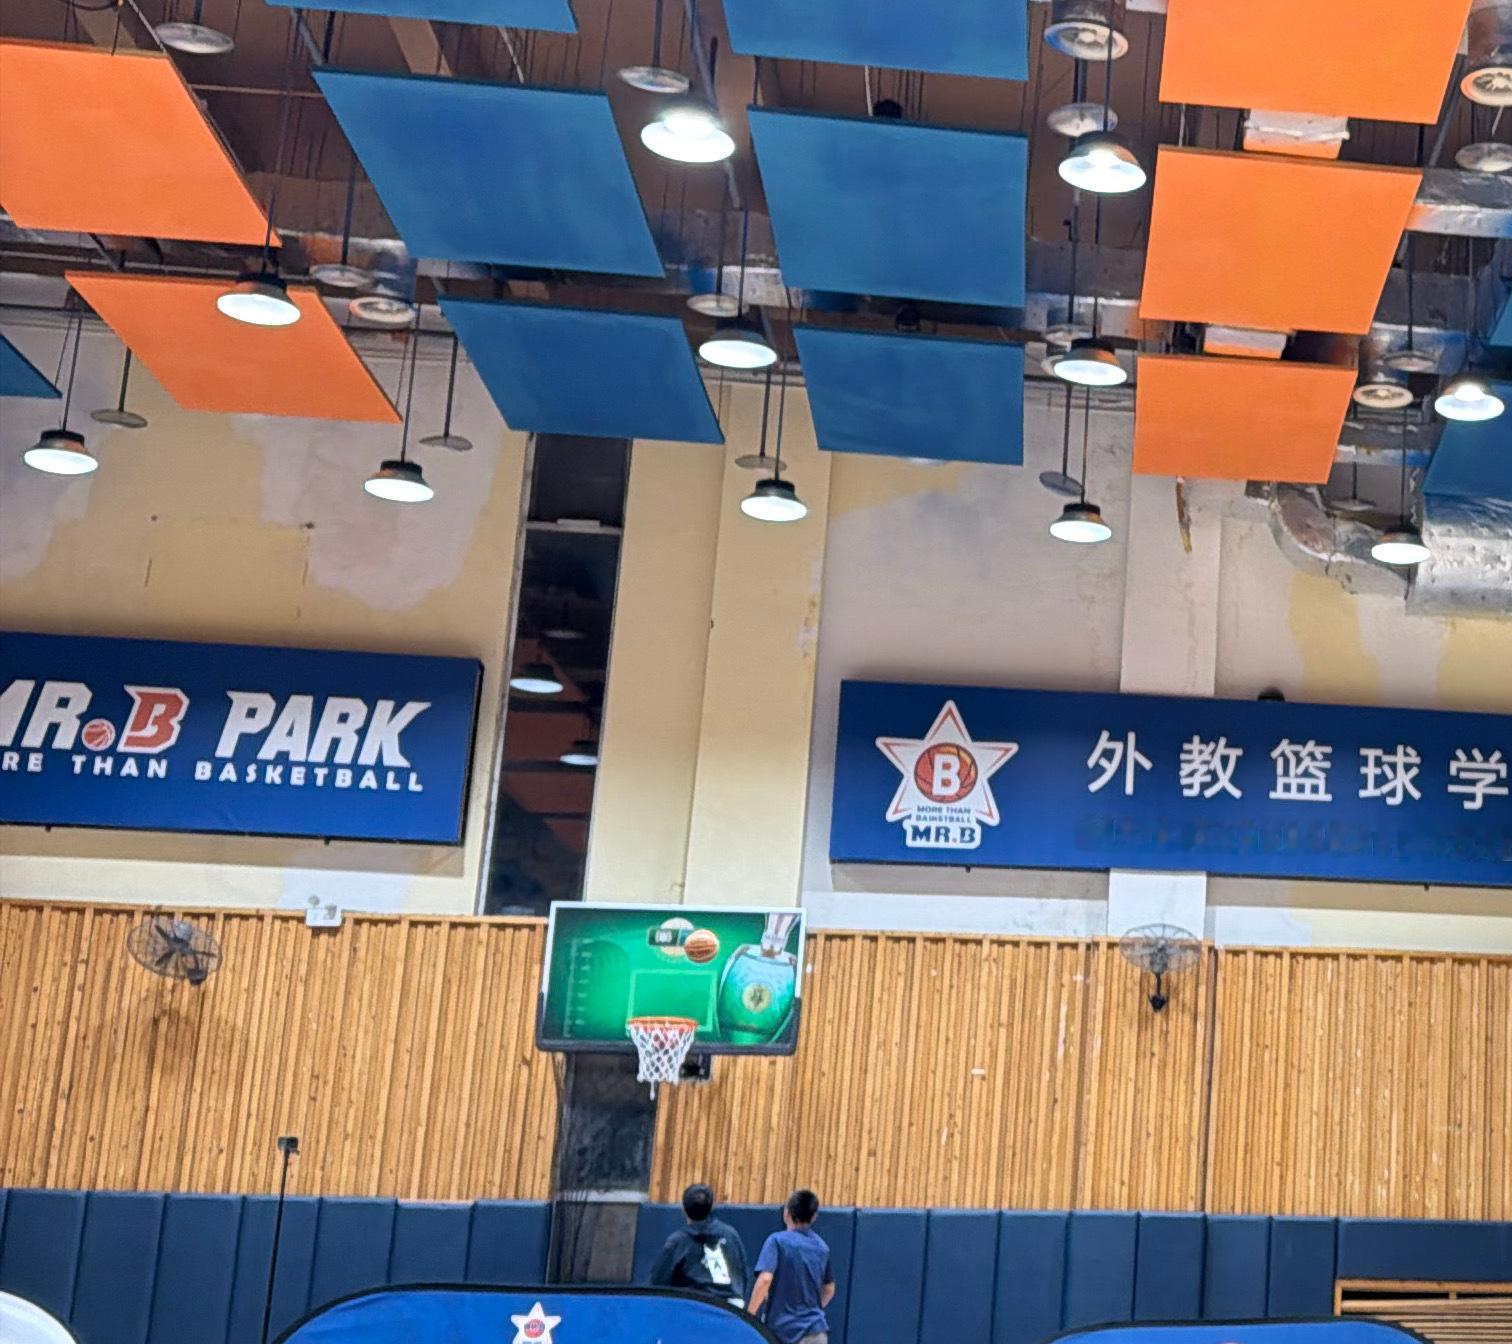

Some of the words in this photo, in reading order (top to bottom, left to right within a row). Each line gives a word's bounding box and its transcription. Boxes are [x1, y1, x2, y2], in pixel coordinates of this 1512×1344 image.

[214, 690, 432, 768] PARK
[71, 754, 168, 779] THAN
[194, 760, 424, 792] BASKETBALL
[931, 754, 961, 796] B
[916, 805, 943, 813] MORE
[946, 805, 972, 814] THAN
[910, 824, 976, 843] MR.B
